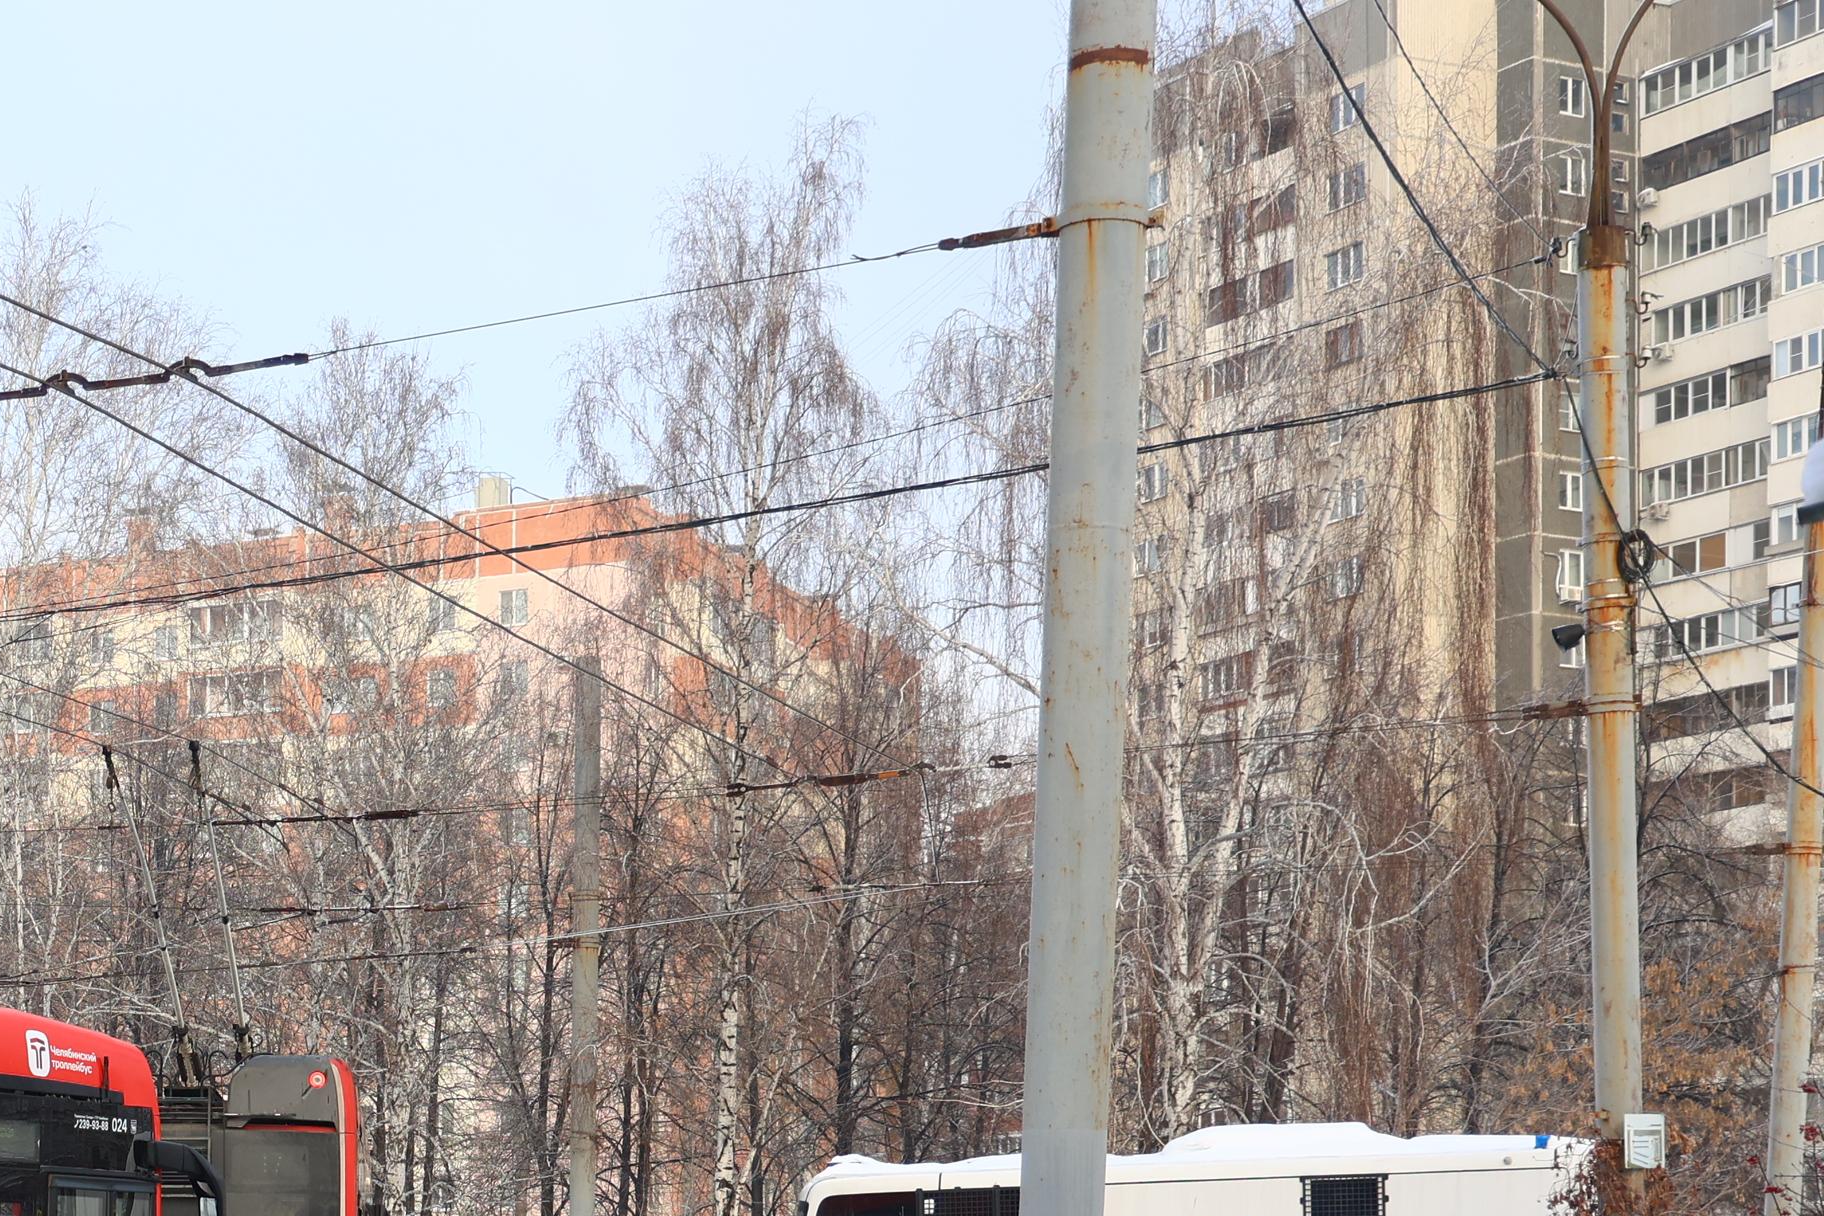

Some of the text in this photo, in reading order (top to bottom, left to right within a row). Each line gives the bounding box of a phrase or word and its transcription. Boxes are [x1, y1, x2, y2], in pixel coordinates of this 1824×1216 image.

[50, 1045, 96, 1062] Челябинский
[51, 1060, 92, 1075] троллейбус
[111, 1117, 127, 1134] 024
